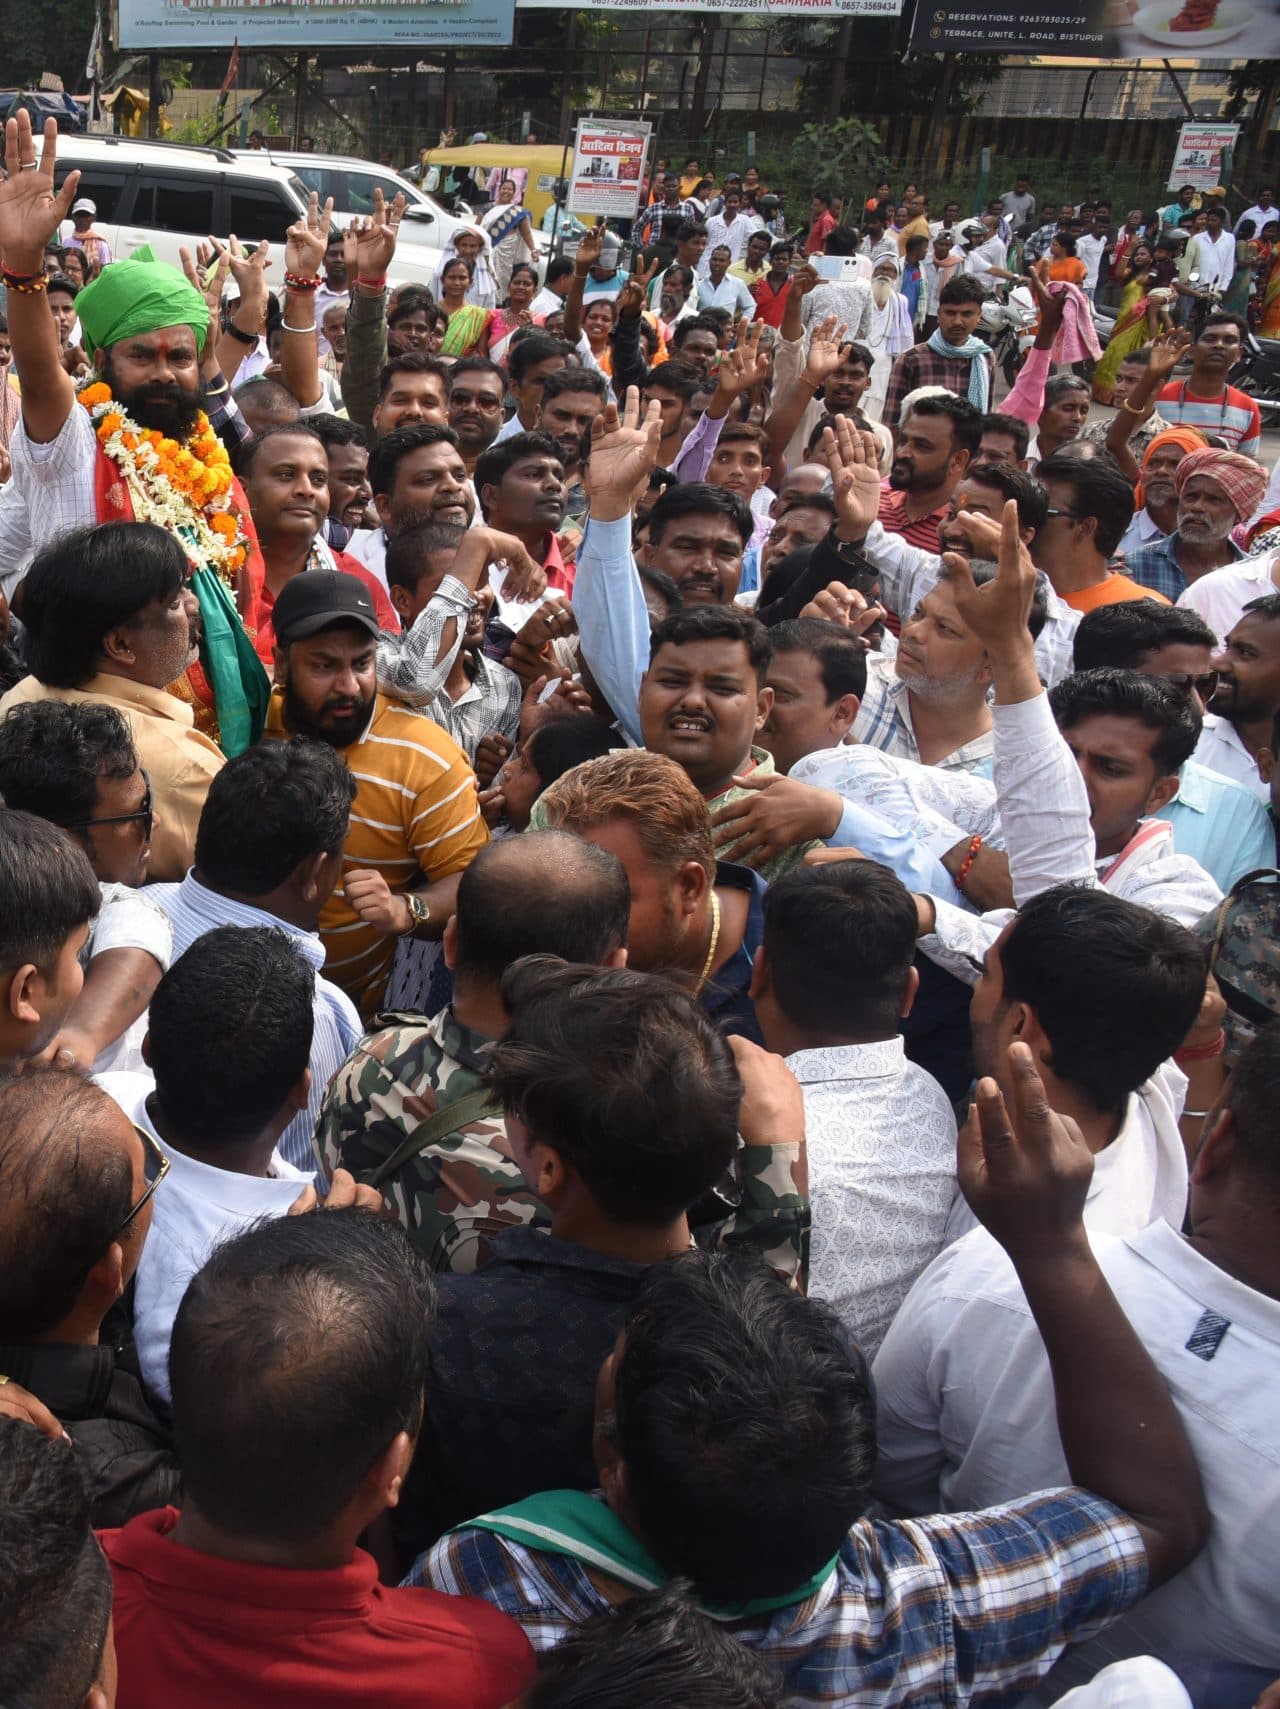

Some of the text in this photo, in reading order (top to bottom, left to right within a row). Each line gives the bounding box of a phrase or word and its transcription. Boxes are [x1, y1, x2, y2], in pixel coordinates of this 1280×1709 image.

[841, 1, 897, 10] 0657-3569434
[948, 14, 1016, 22] RESERVATIONS:
[944, 29, 985, 38] TERRACE,
[1030, 32, 1057, 40] ROAD,
[1060, 33, 1104, 41] BISTUPUR
